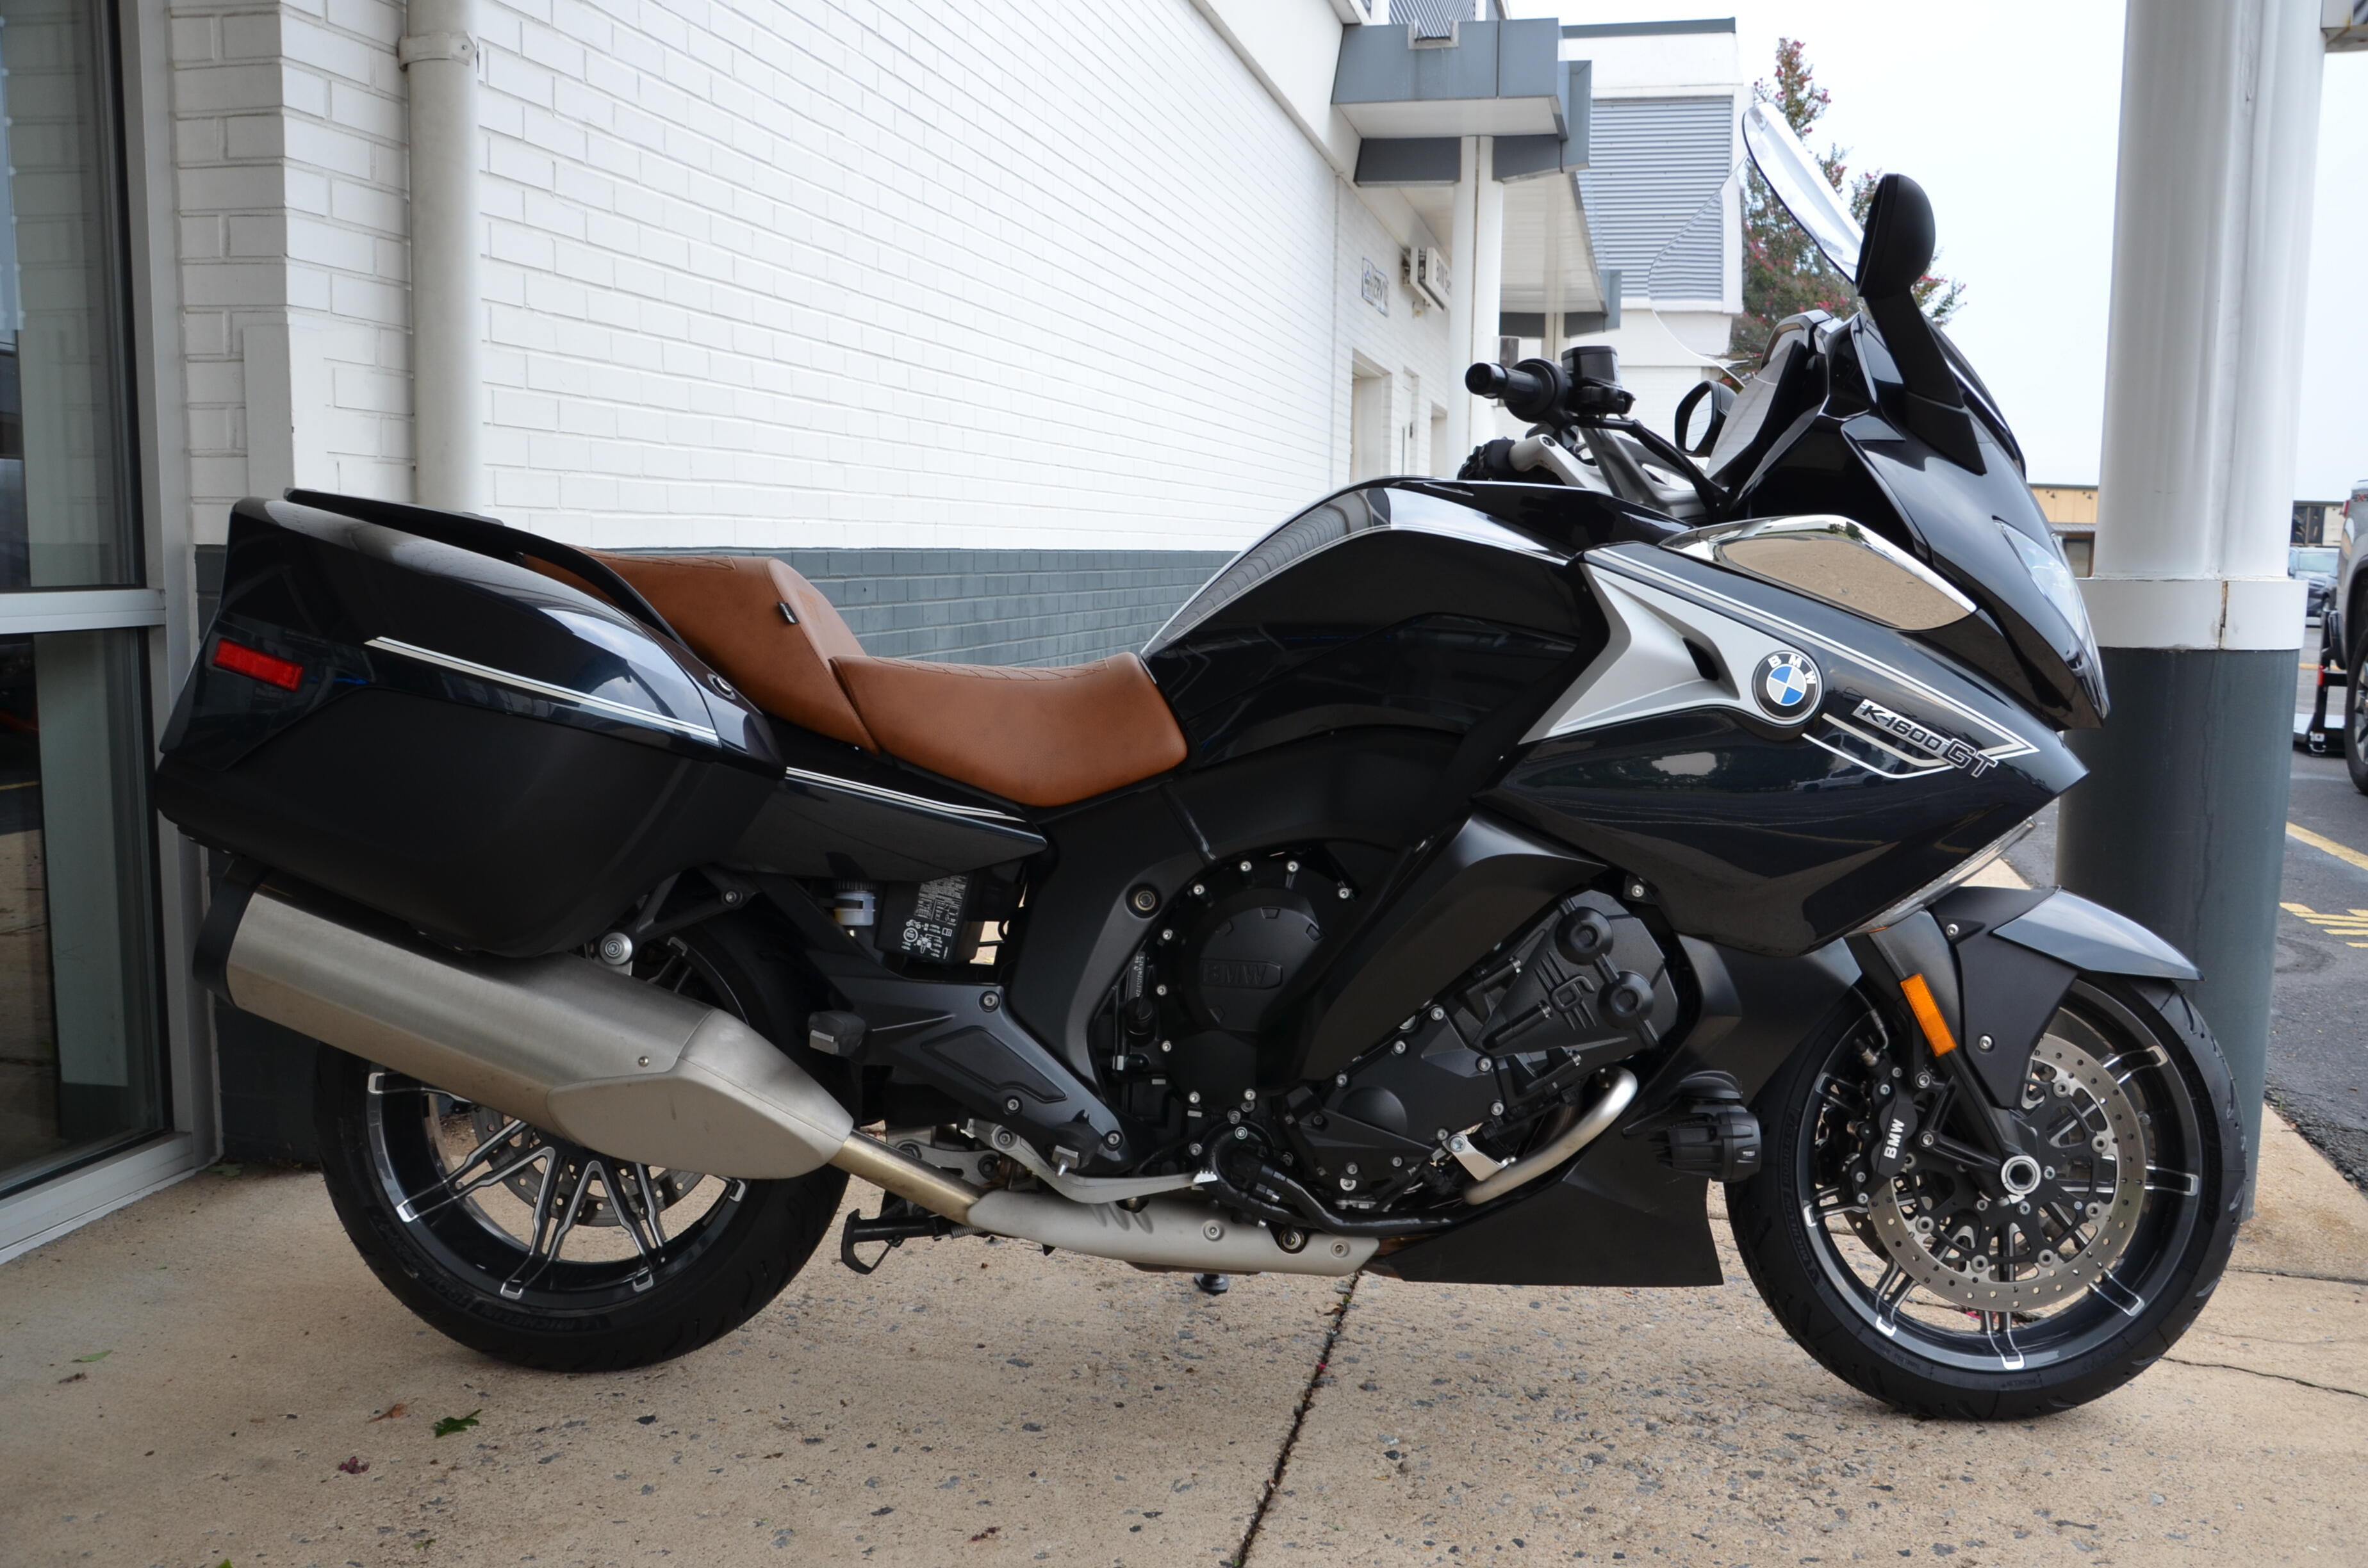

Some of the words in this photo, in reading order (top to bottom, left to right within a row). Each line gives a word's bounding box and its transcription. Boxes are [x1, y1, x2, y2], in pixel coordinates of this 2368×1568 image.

[1767, 655, 1817, 685] BMW
[1943, 739, 1998, 779] GT
[1203, 962, 1267, 984] BMW
[1883, 1118, 1905, 1159] BMW
